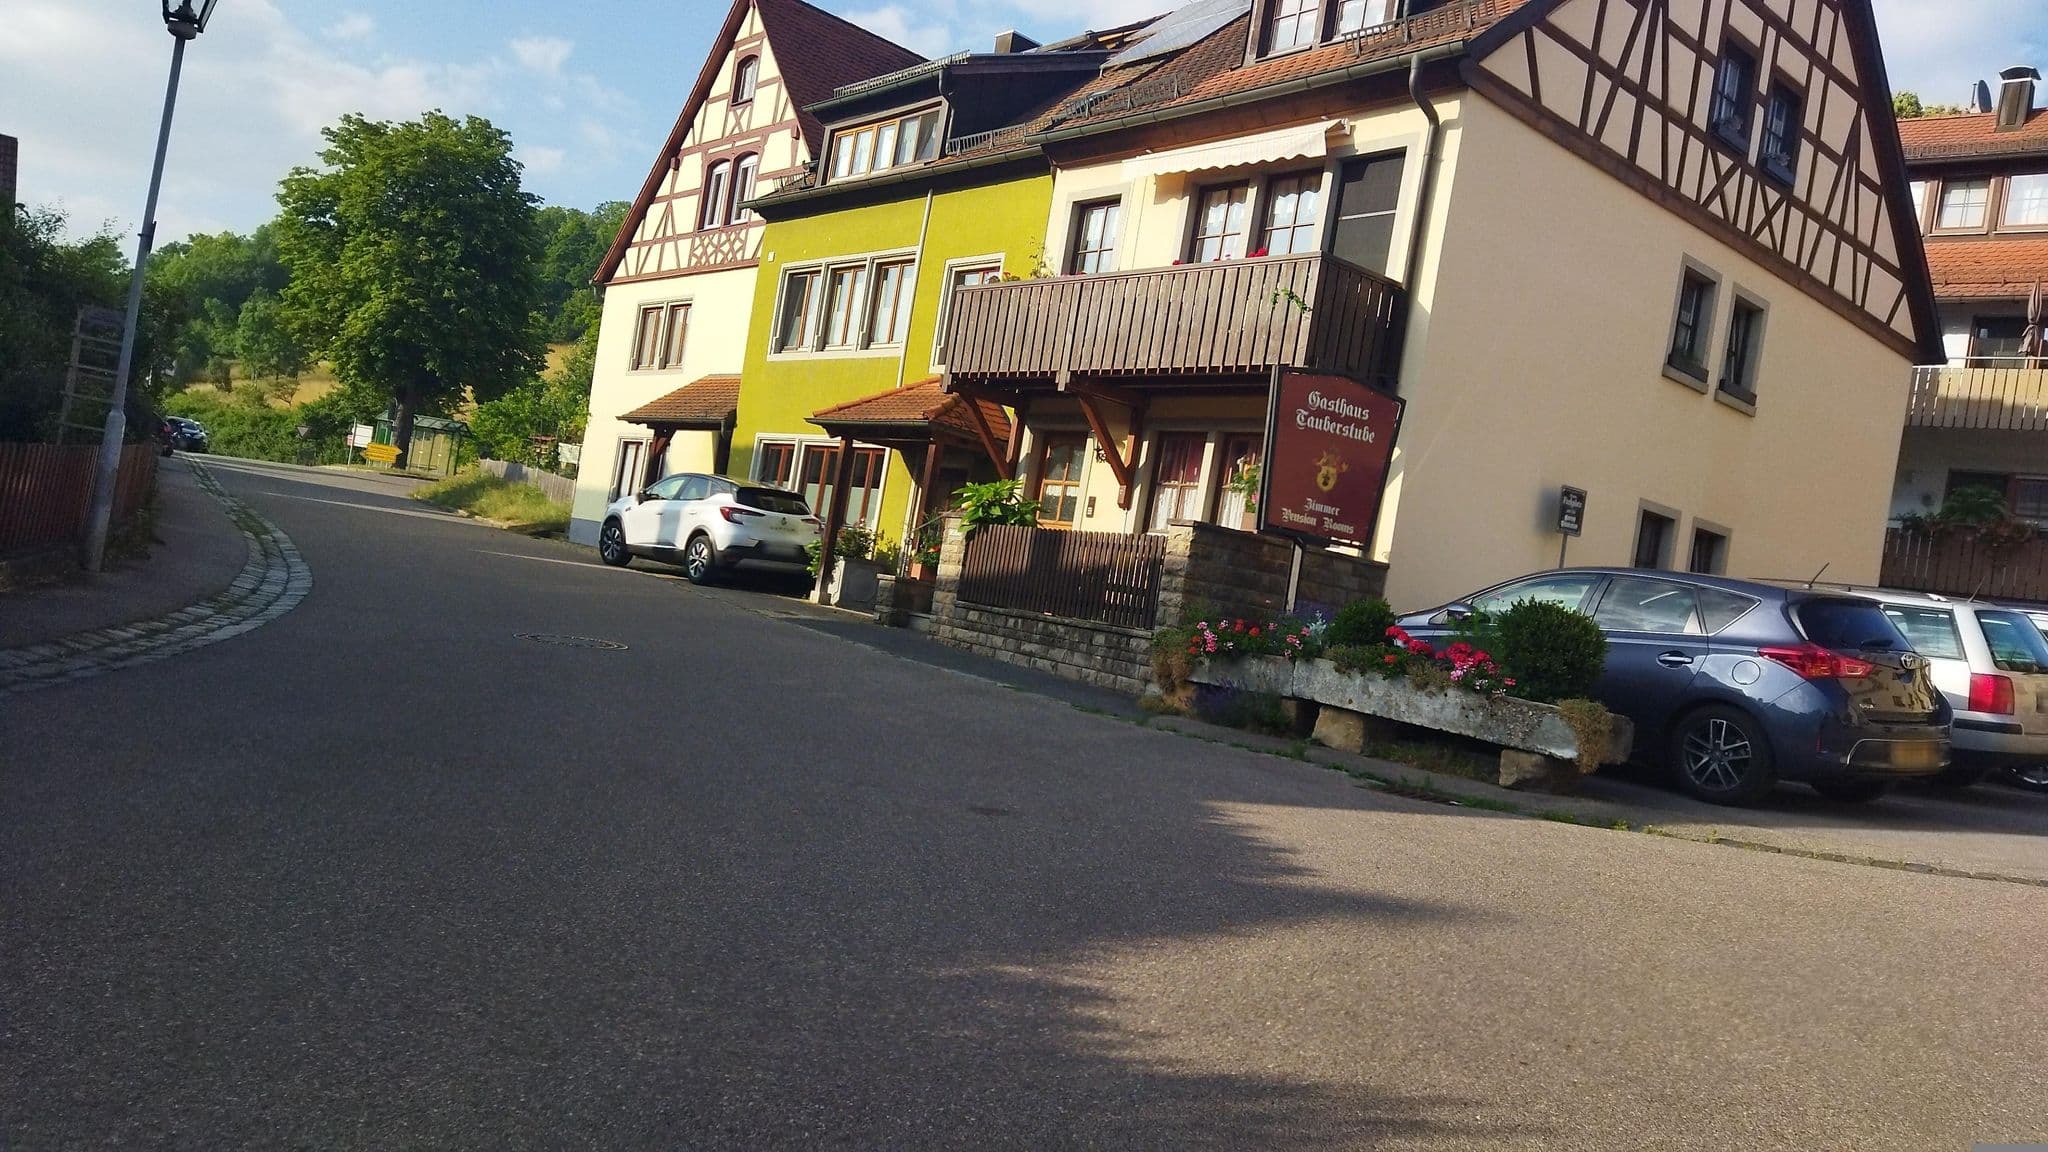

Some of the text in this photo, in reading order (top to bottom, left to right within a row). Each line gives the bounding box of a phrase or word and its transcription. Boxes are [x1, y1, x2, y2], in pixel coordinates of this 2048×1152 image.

[1308, 390, 1370, 420] Gasthaus
[1295, 408, 1375, 443] Tauberstube
[1303, 497, 1341, 516] Zimmer
[1281, 508, 1354, 535] Pension Rooms
